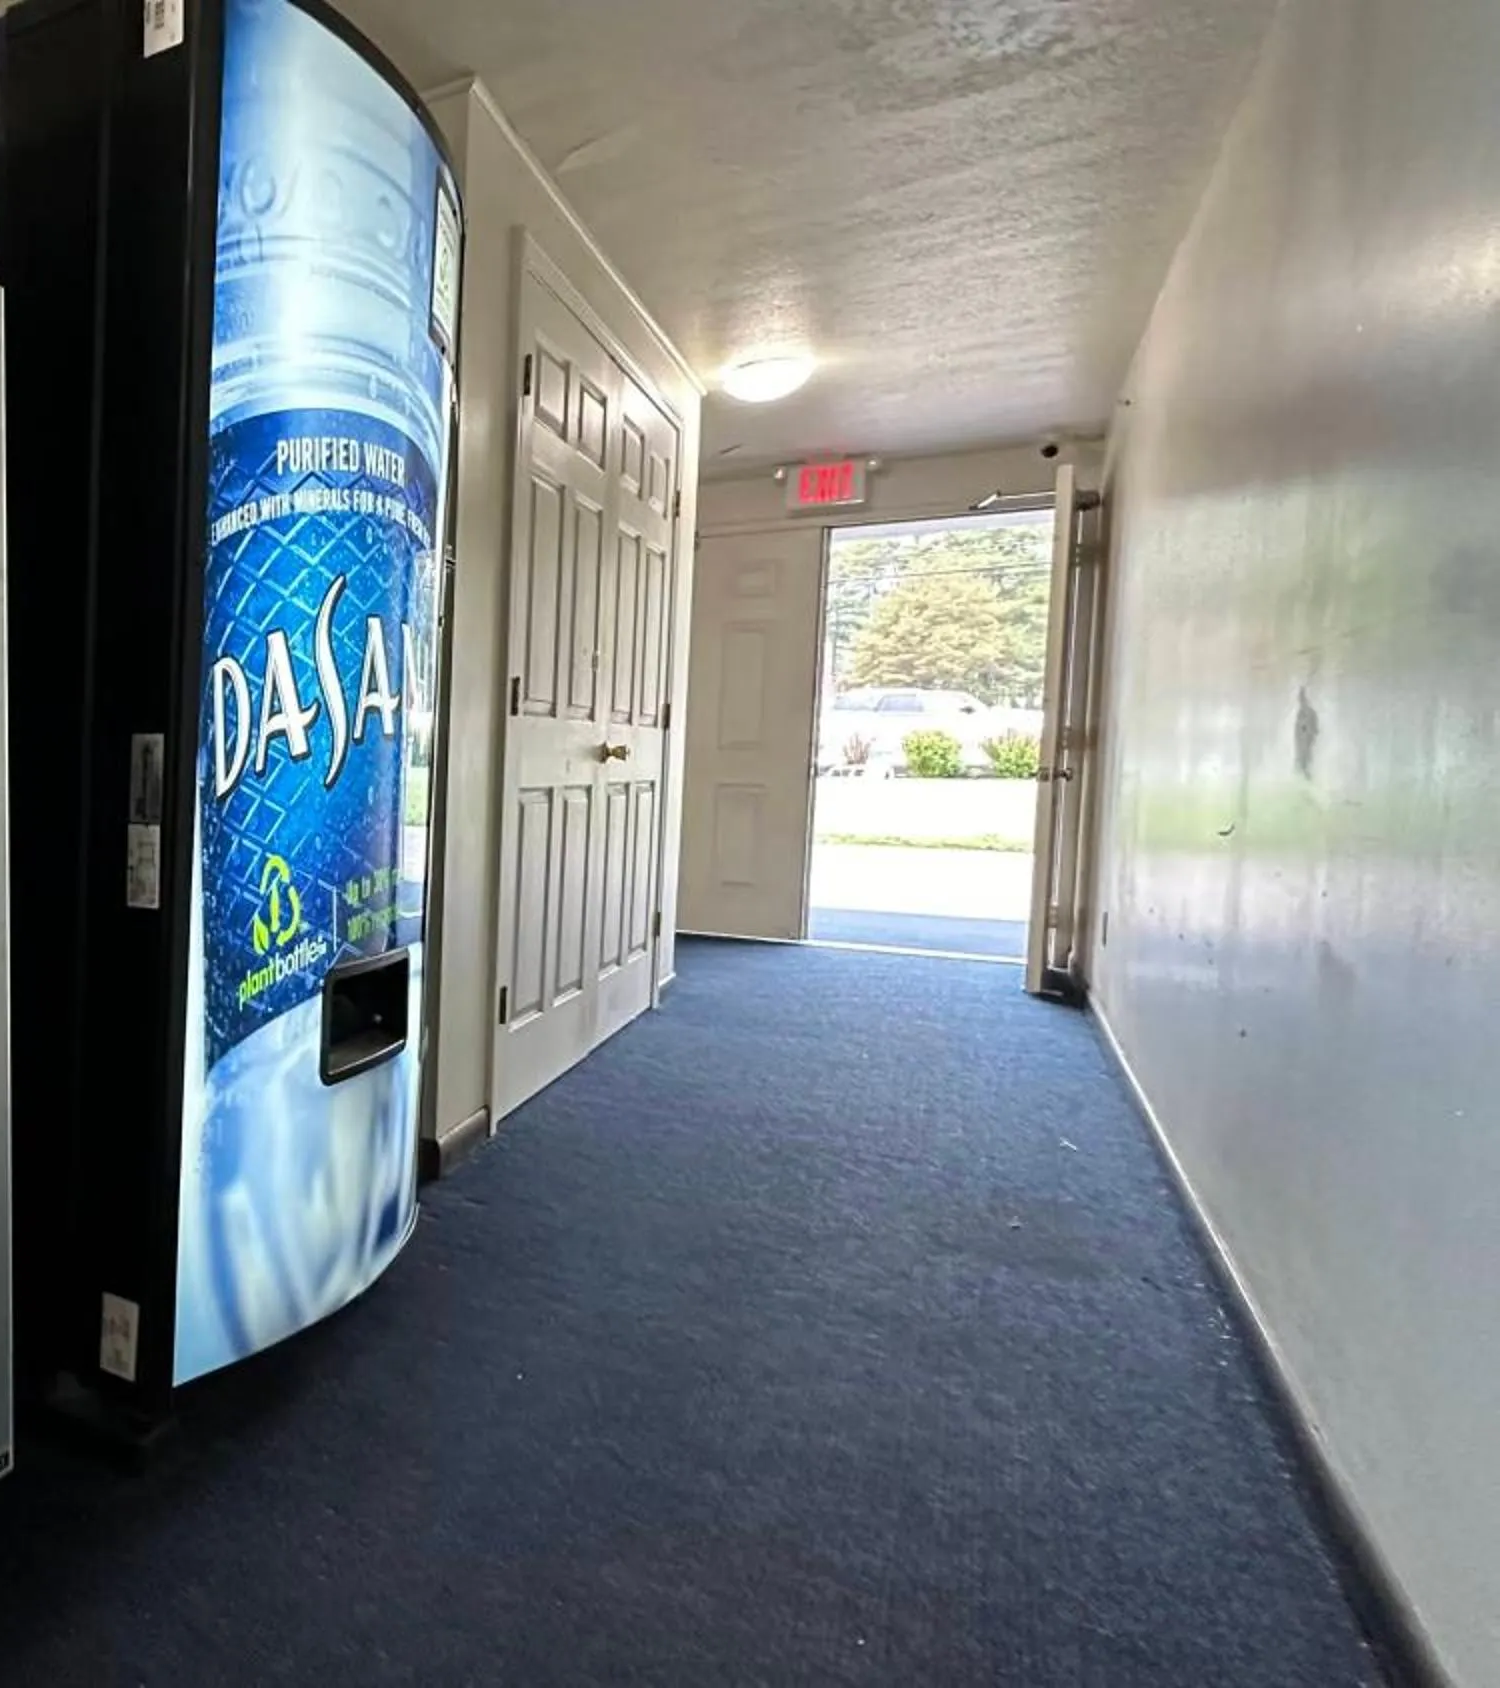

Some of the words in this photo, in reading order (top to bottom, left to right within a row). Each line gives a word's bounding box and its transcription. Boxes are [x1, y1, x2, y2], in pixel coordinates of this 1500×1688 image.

[277, 437, 359, 475] PURIFIED
[363, 442, 405, 489] WATER
[799, 463, 853, 505] EXIT
[259, 494, 290, 526] WITH
[293, 485, 349, 514] MINERALS
[353, 487, 374, 515] FOR
